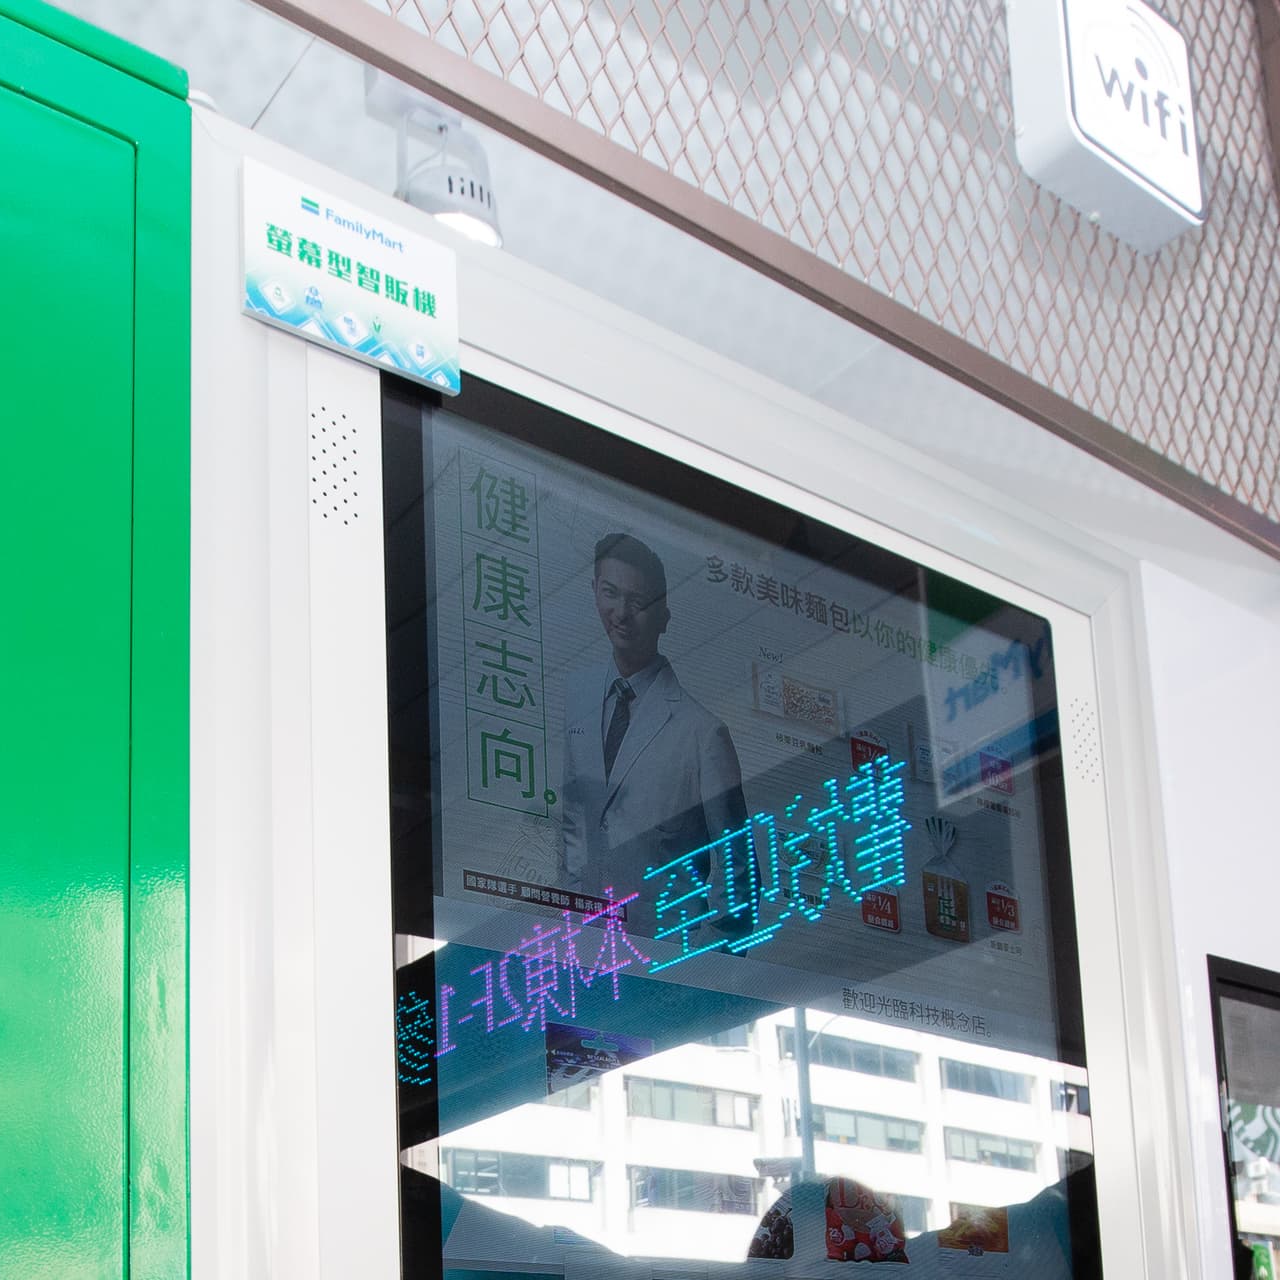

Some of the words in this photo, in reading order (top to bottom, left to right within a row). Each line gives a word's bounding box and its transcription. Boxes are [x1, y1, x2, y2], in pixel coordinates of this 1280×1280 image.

[325, 208, 404, 254] FamilyMart
[265, 222, 437, 318] 螢幕型智販機
